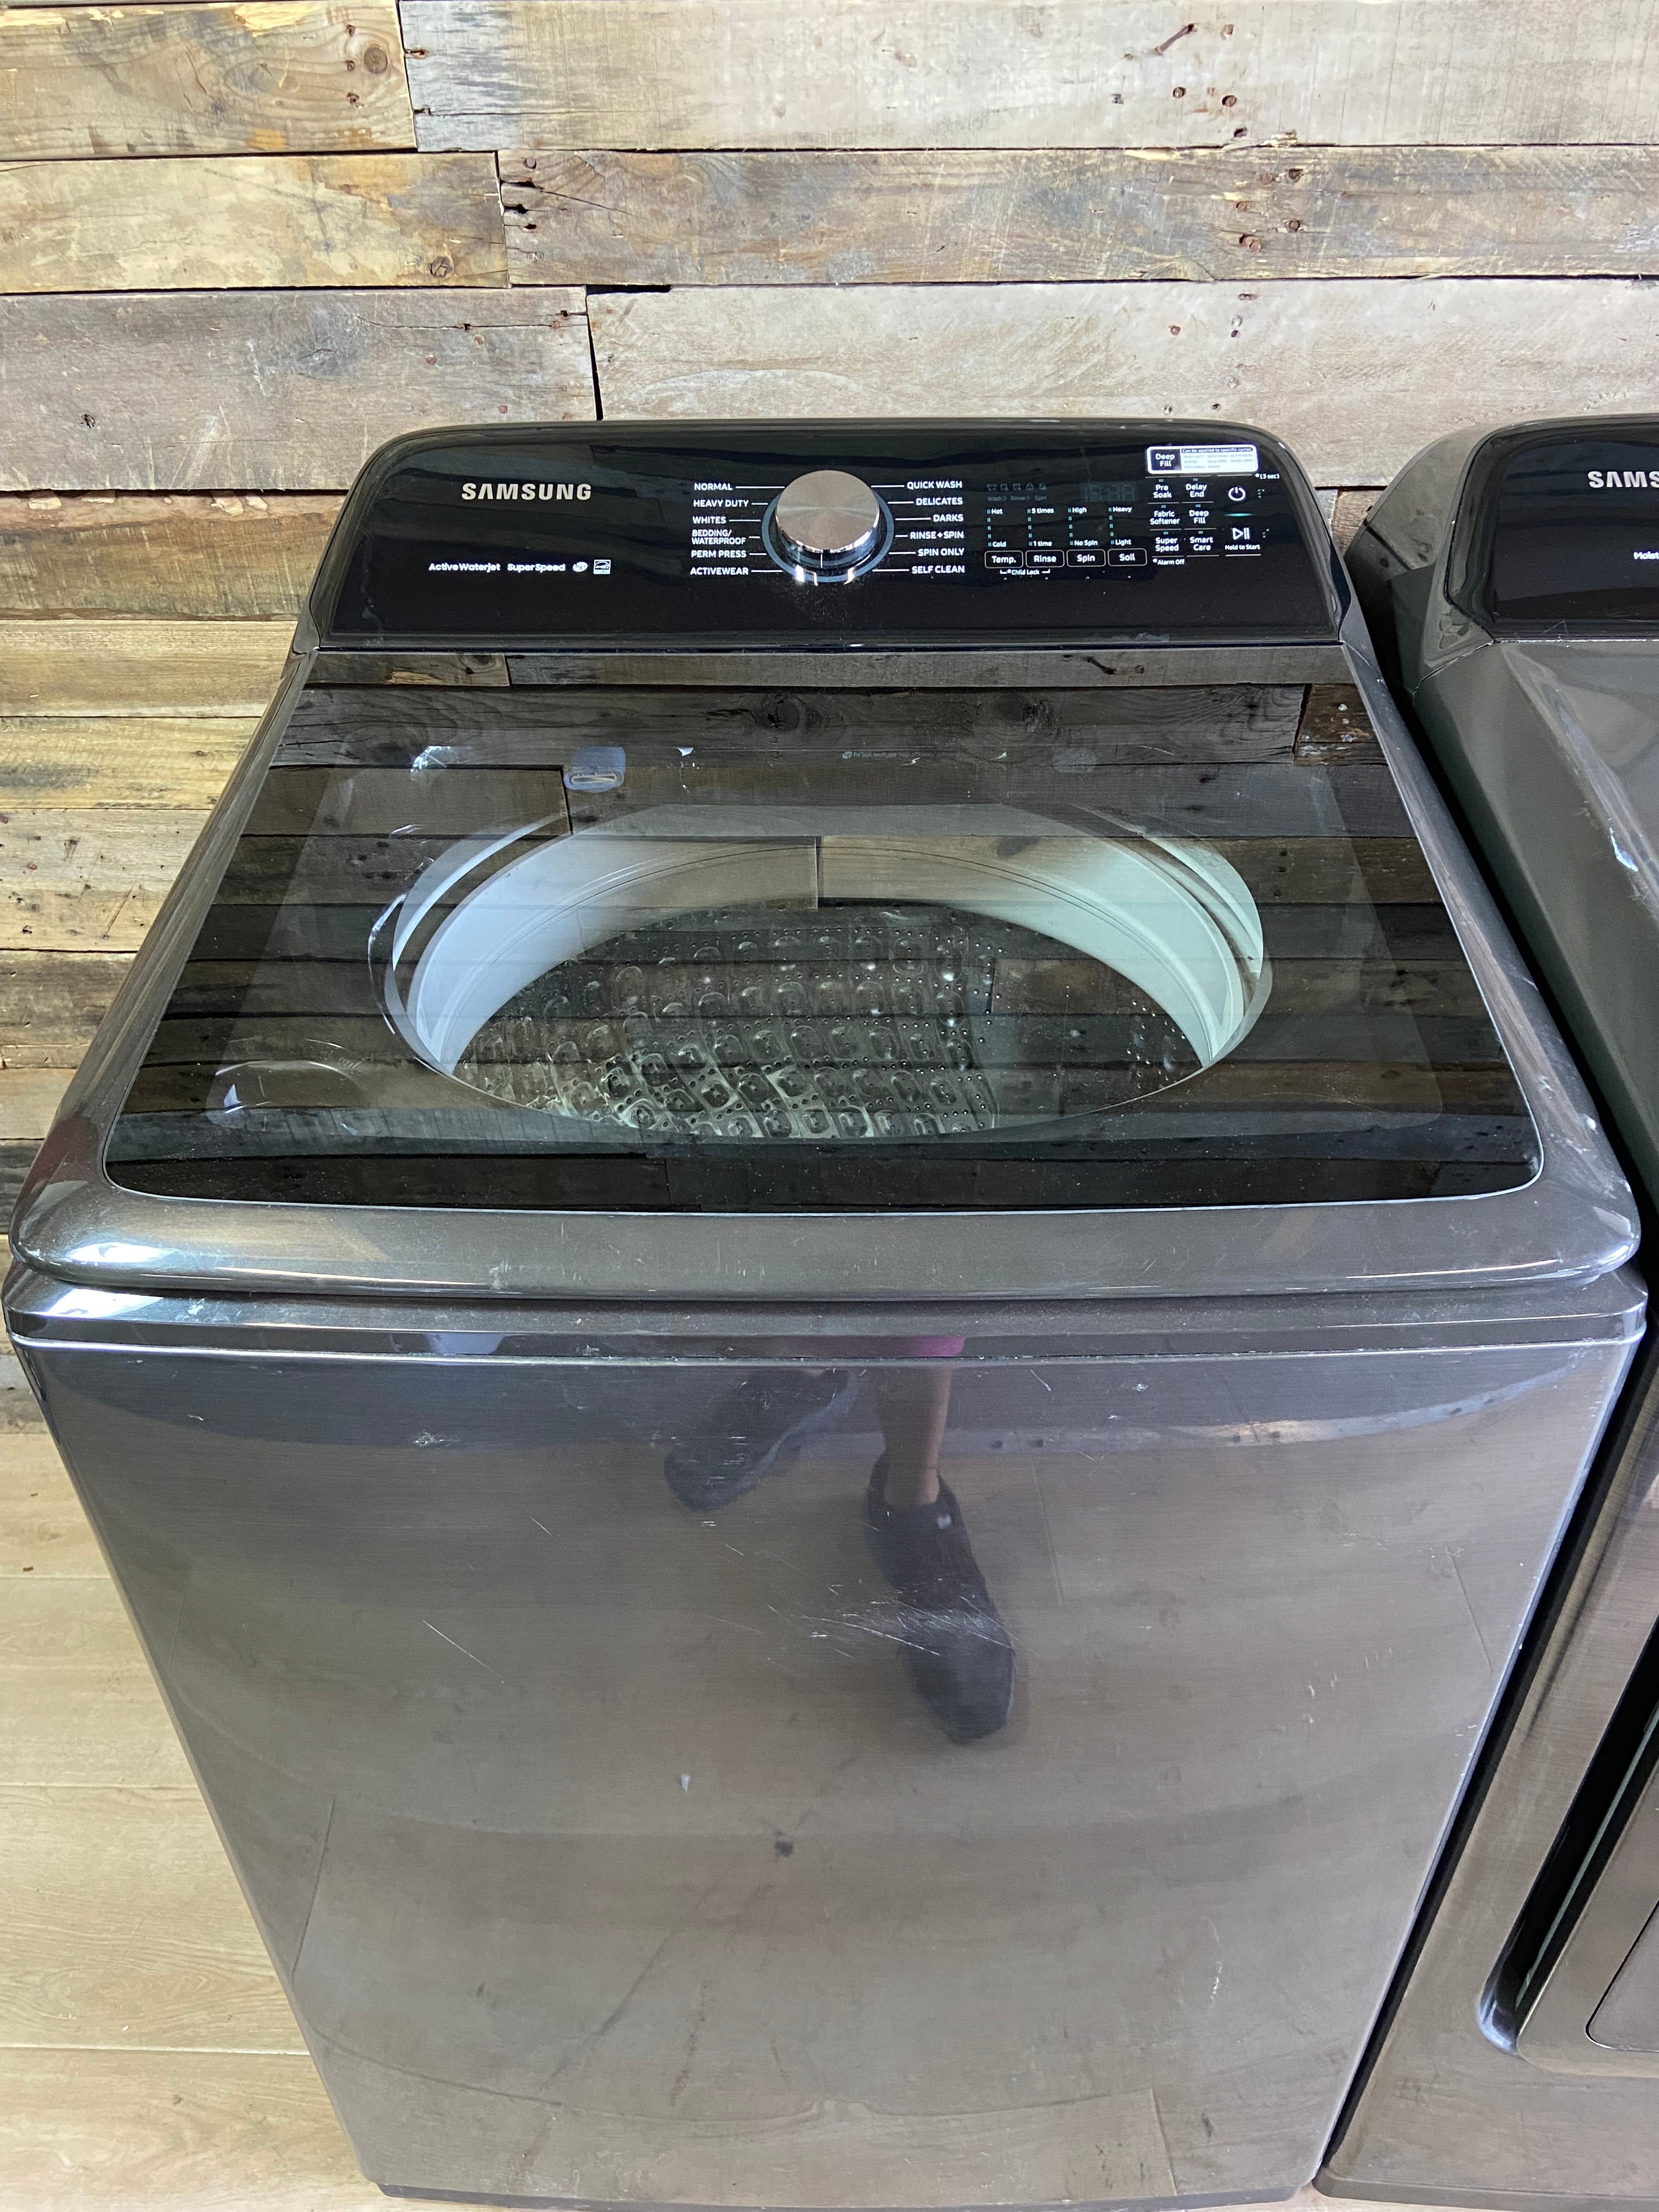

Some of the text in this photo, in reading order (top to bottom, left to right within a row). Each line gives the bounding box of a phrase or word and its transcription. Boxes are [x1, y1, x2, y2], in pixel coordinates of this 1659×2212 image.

[1588, 471, 1659, 488] SAMS
[907, 481, 934, 490] QUICK
[462, 483, 591, 500] SAMSUNG
[1155, 537, 1178, 545] Super
[1155, 544, 1179, 552] Speed
[991, 556, 1016, 564] Temp.
[1077, 554, 1095, 563] Spin
[912, 566, 933, 574] SELF
